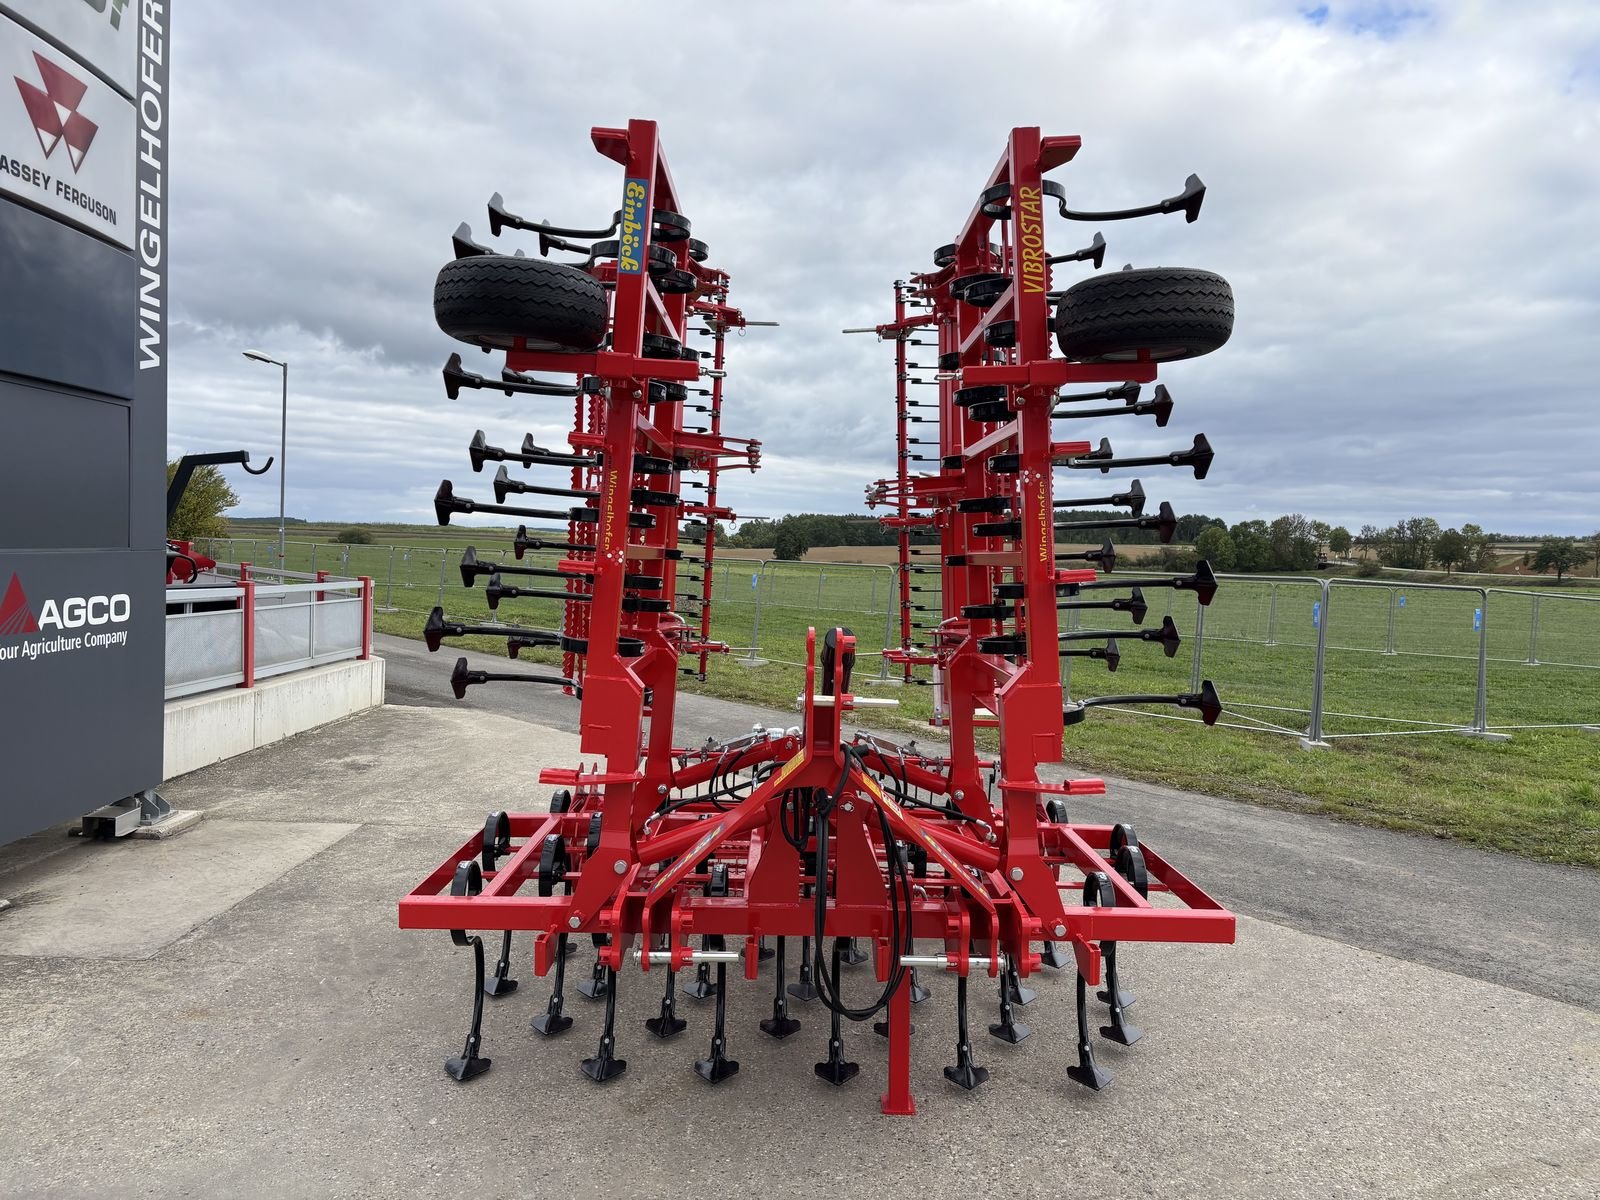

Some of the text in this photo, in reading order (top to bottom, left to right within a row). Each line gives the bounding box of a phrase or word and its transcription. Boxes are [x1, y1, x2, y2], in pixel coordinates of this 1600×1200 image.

[56, 179, 117, 226] FERGUSON
[140, 0, 163, 370] WINGELHOFER
[620, 181, 645, 271] Einböck
[1019, 186, 1044, 293] VIBROSTAR
[0, 630, 128, 660] our Agriculture Company
[38, 594, 130, 631] AGCO
